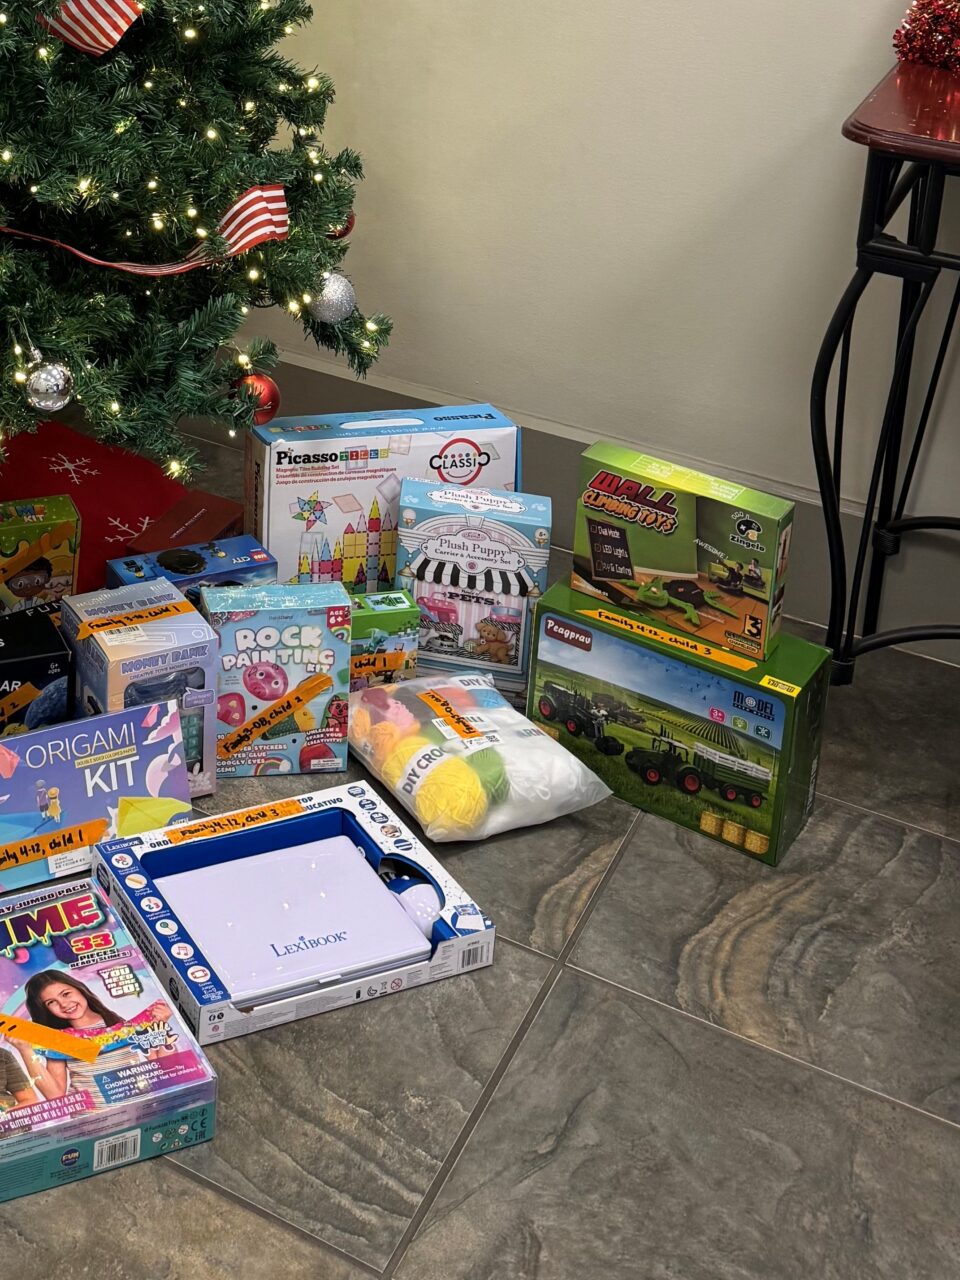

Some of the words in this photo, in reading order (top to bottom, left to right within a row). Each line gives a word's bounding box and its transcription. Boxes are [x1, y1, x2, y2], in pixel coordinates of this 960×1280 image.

[587, 469, 679, 516] WALL
[639, 507, 679, 534] TOYS
[440, 538, 469, 552] Plush
[472, 543, 507, 557] Puppy
[500, 556, 511, 565] Set
[448, 590, 496, 606] PETS
[235, 625, 323, 651] ROCK
[121, 652, 170, 675] MONEY
[171, 644, 209, 663] BANK
[221, 648, 335, 671] PAINTING
[703, 646, 712, 656] 3
[306, 663, 332, 673] KIT
[354, 657, 379, 669] child
[25, 722, 136, 769] ORIGAMI
[84, 755, 140, 798] KIT
[403, 767, 419, 796] DIY
[15, 893, 56, 911] JUMBO
[57, 883, 90, 898] PACK
[71, 932, 116, 953] 33
[80, 948, 117, 961] PIECES
[100, 966, 130, 980] YOU
[117, 1061, 162, 1078] WARNING:
[104, 1076, 136, 1090] CHOKING
